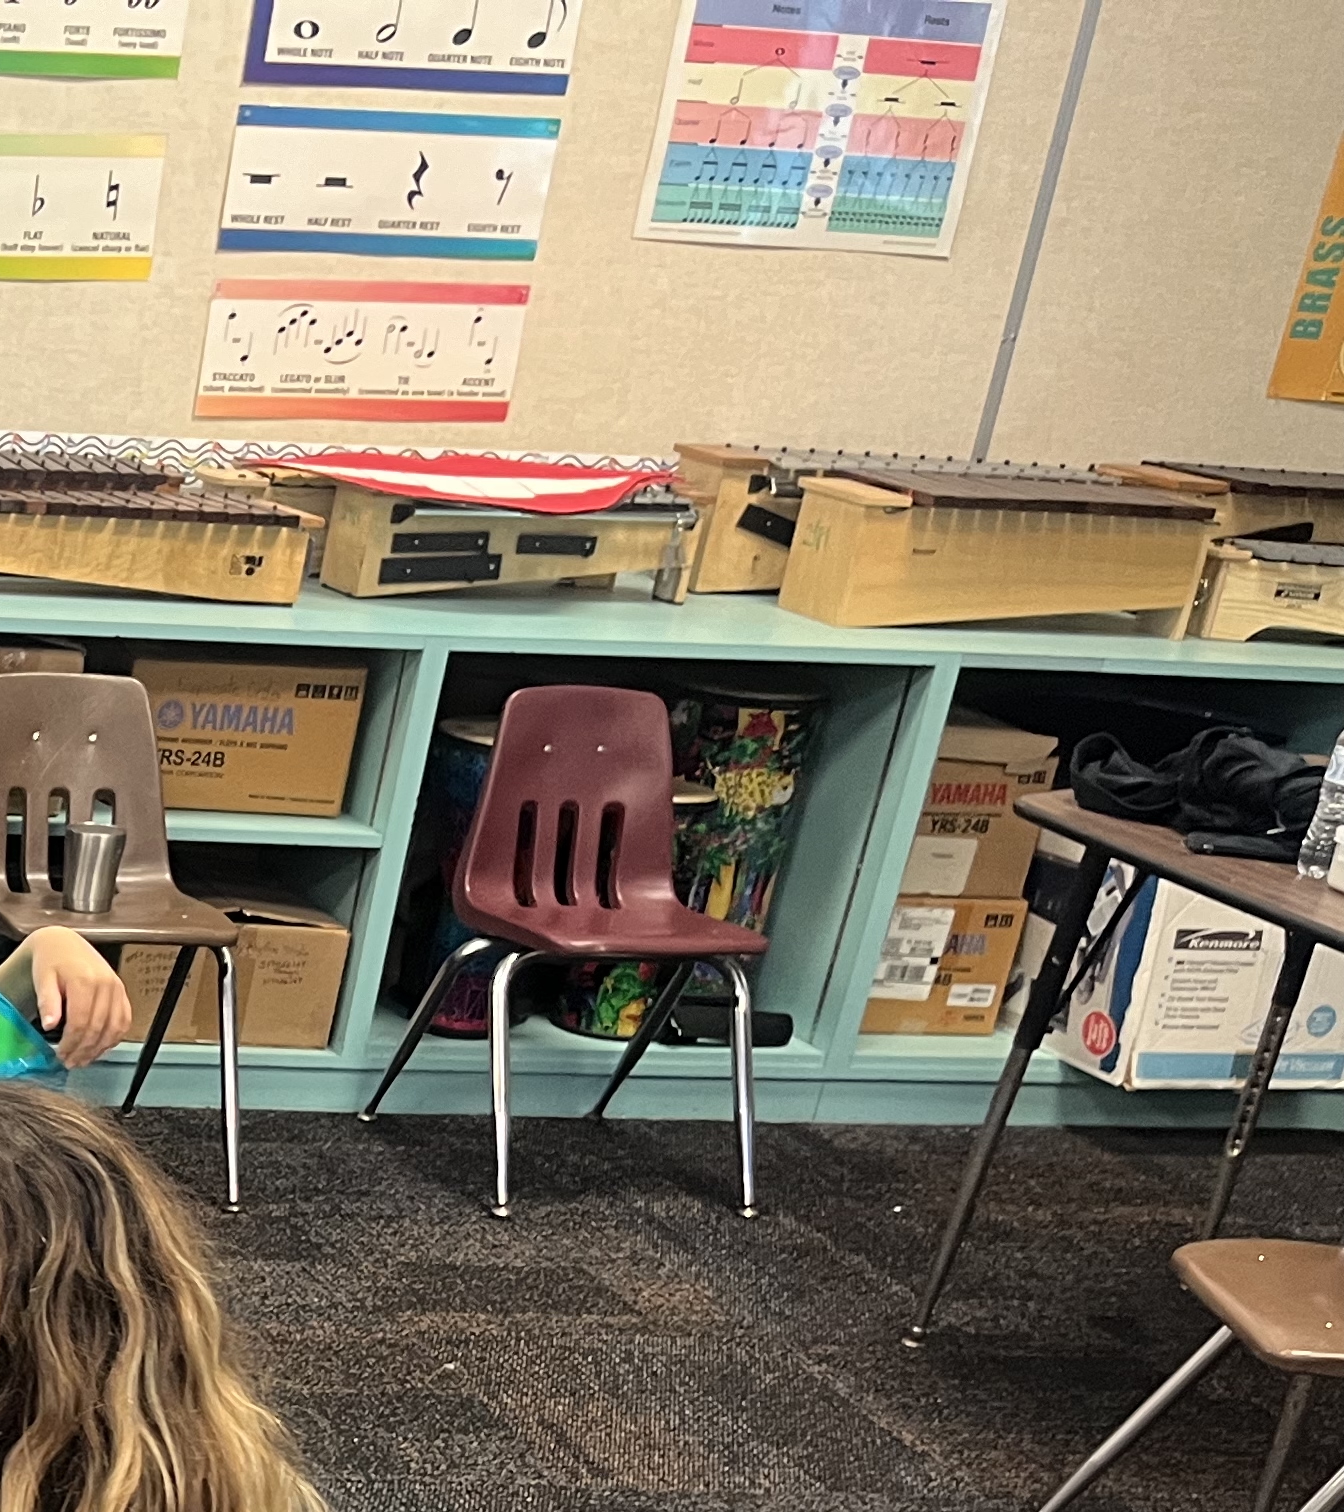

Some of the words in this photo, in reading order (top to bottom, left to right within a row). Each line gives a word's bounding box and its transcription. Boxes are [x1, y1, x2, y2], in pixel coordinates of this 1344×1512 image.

[277, 47, 308, 59] WHOLE
[311, 47, 333, 59] NOTE
[358, 50, 379, 61] HALF
[381, 51, 404, 62] NOTE
[428, 52, 469, 65] QUARTER
[471, 54, 492, 66] NOTE
[542, 57, 565, 69] NOTE
[230, 213, 261, 225] WHOLE
[264, 214, 284, 225] REST
[330, 217, 351, 228] REST
[378, 219, 417, 230] QUARTER
[419, 220, 440, 231] REST
[1289, 215, 1344, 340] BRASS
[212, 372, 255, 382] STACCATO
[279, 374, 311, 384] LEGATO
[190, 702, 296, 736] YAMAHA
[930, 783, 1008, 806] YAMAHA
[1188, 937, 1261, 950] Kenmore
